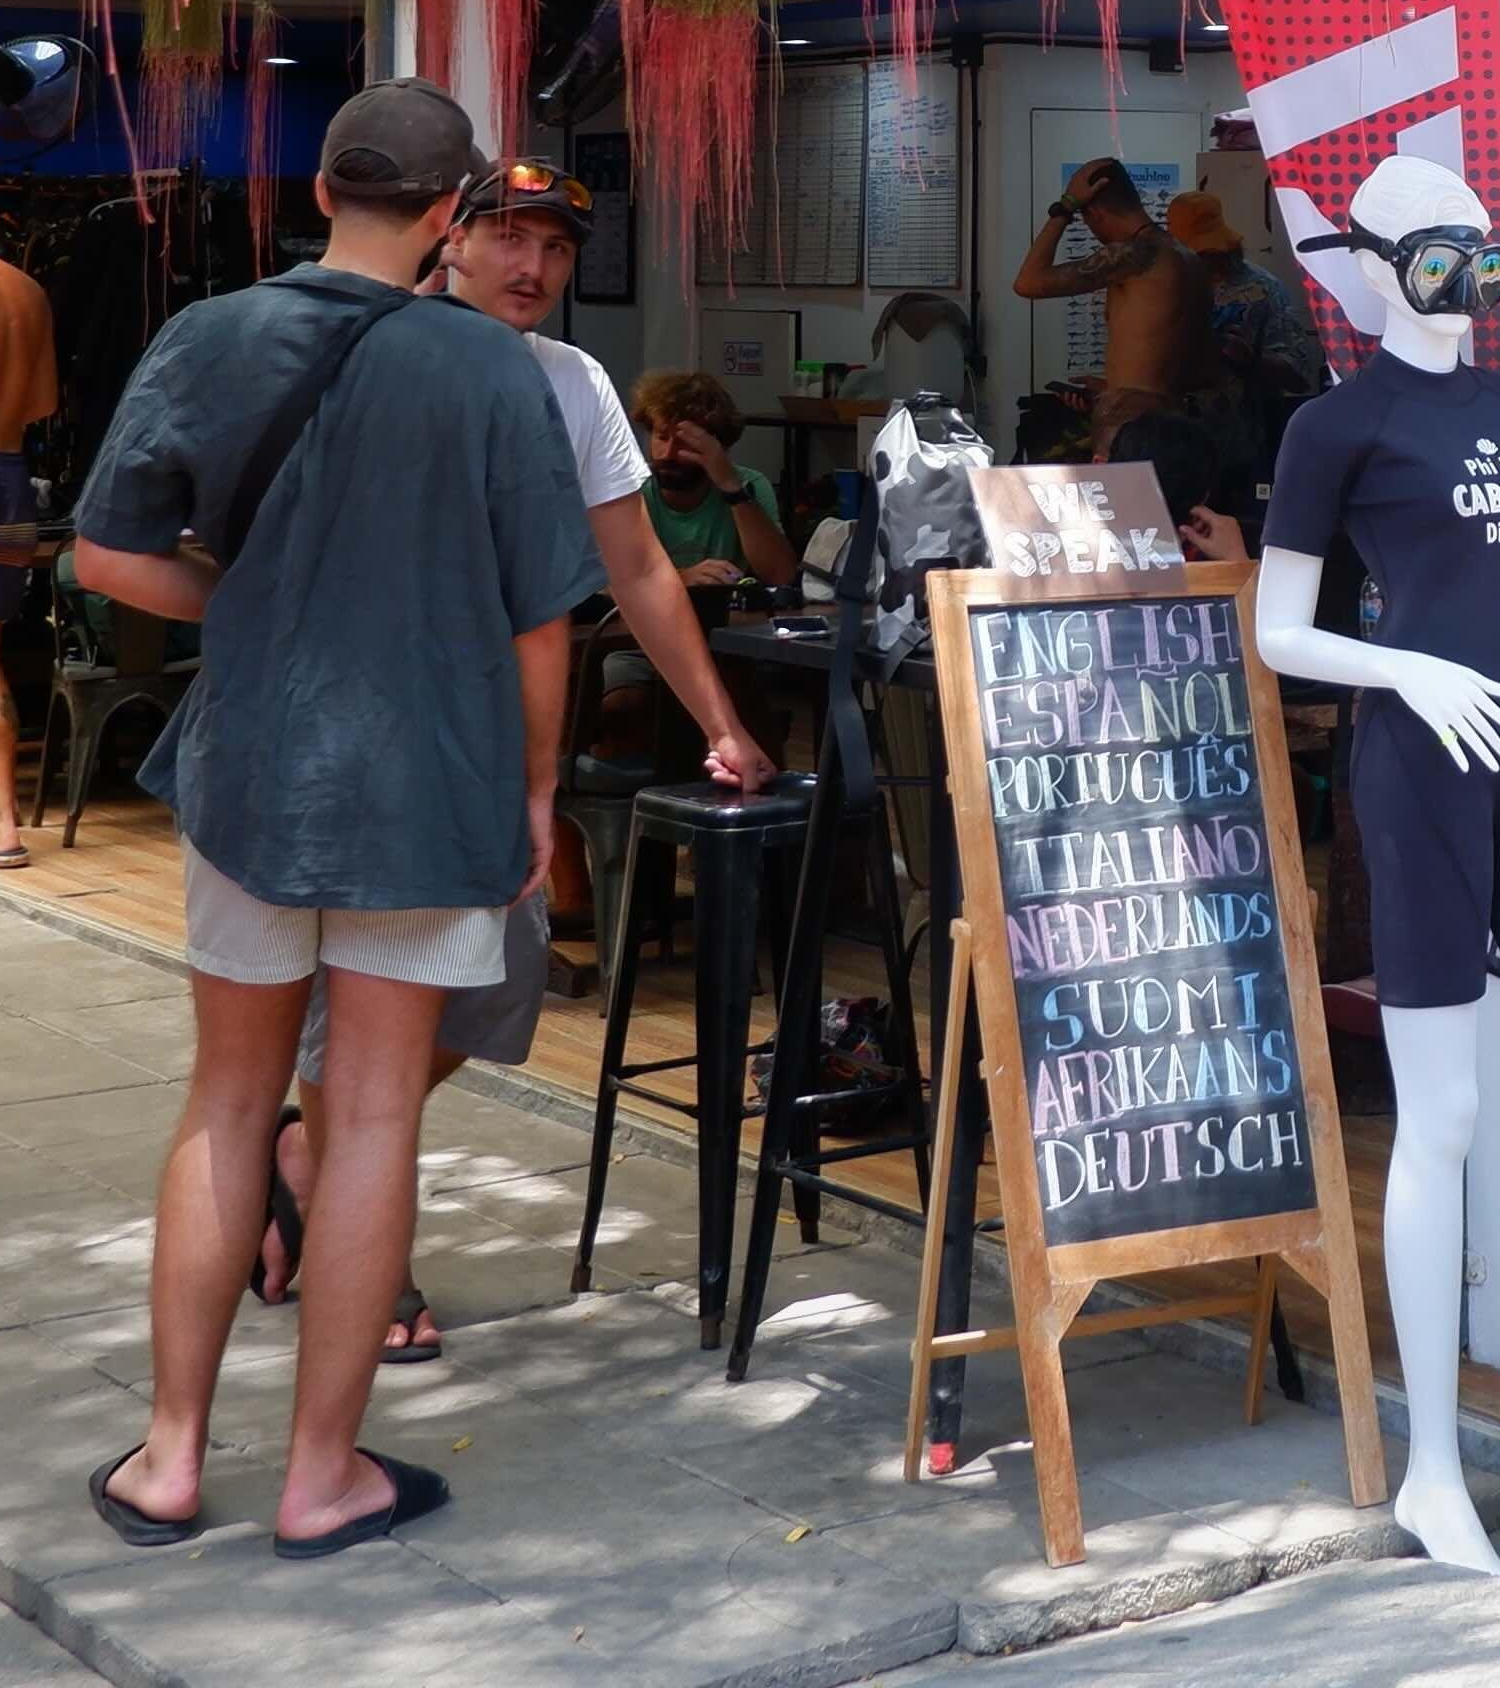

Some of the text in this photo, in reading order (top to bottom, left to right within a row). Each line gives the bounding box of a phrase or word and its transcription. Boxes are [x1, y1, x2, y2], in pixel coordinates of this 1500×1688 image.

[1028, 481, 1115, 523] WE
[1464, 457, 1498, 477] Phi
[1004, 528, 1169, 578] SPEAK
[976, 601, 1241, 682] ENGLISH
[986, 733, 1250, 818] PORTUGUÊS
[1015, 815, 1260, 897] ITALIANO
[1007, 887, 1273, 979] NEDERLANDS
[1042, 971, 1260, 1051] SUOMI
[1033, 1029, 1291, 1139] AFRIKAANS
[1042, 1111, 1304, 1210] DEUTSCH
